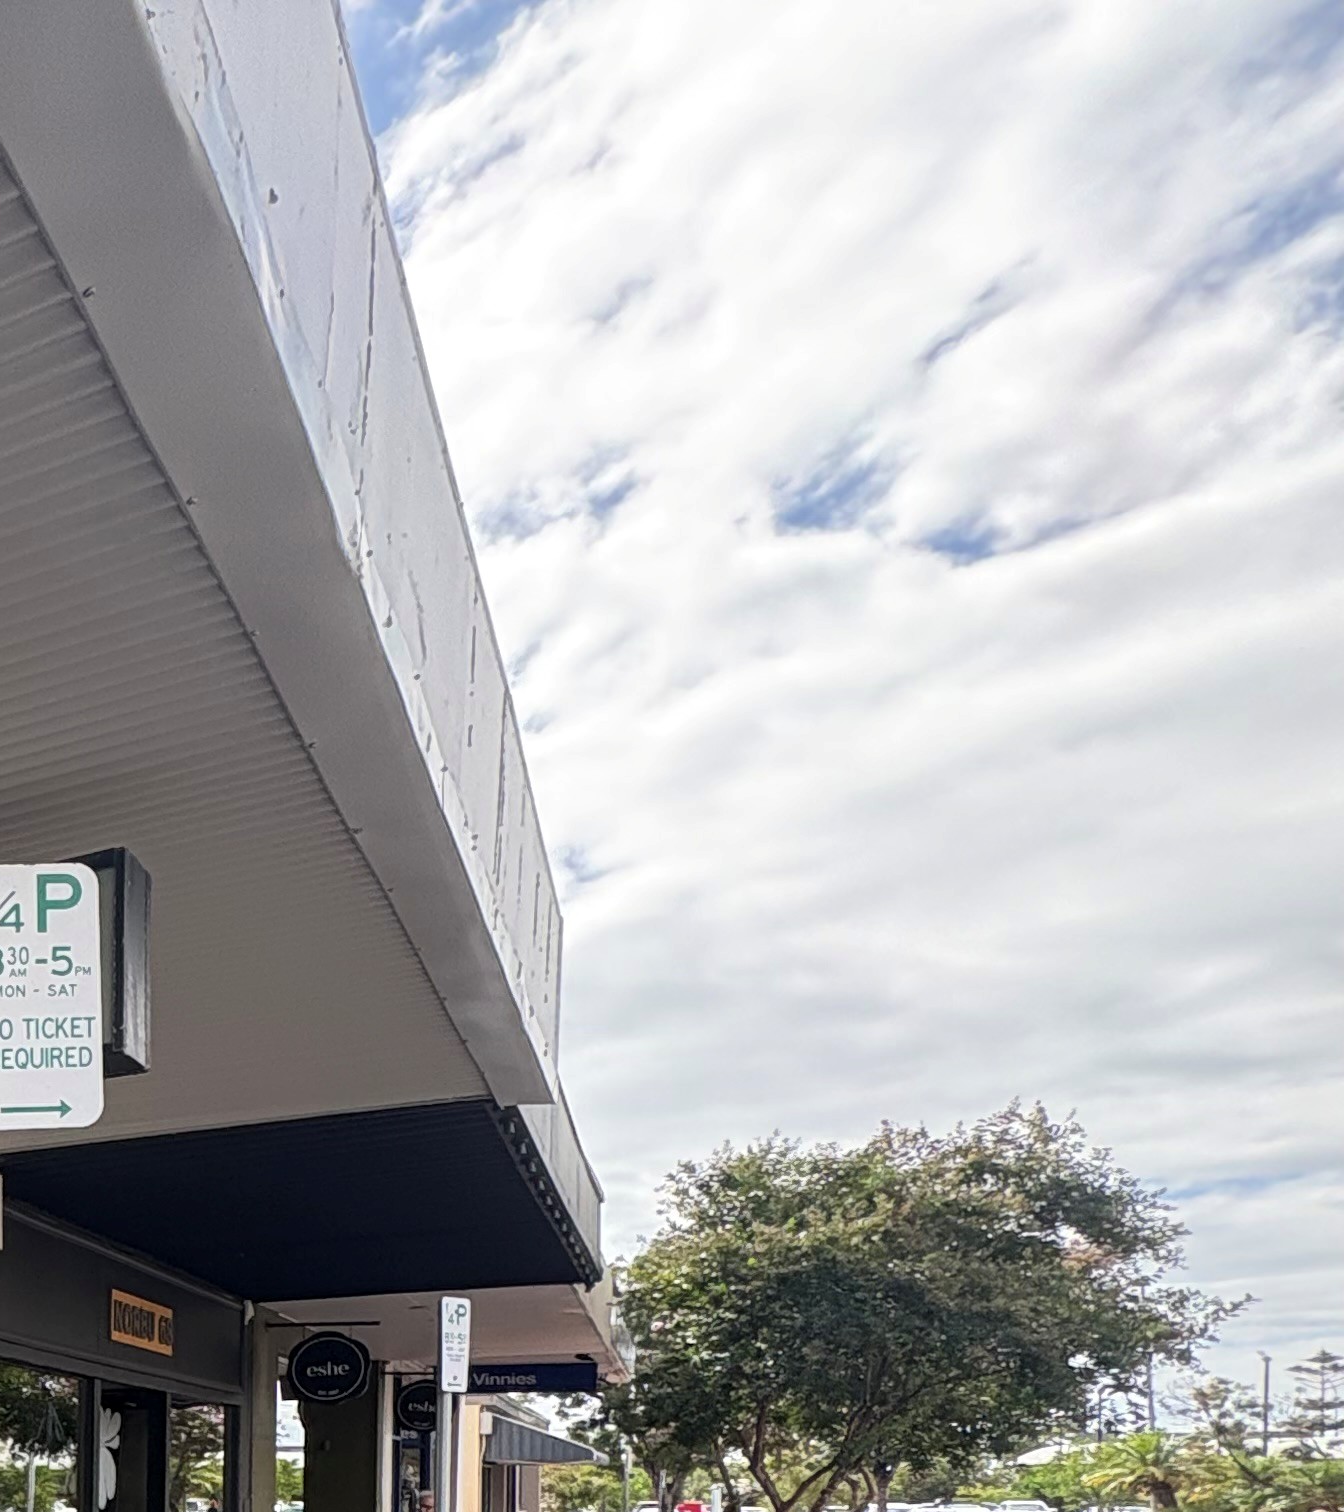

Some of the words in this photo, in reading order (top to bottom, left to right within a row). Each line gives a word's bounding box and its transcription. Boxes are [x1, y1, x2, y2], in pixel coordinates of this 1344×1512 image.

[8, 968, 28, 978] AM
[74, 965, 92, 976] PM
[47, 983, 78, 997] SAT
[22, 1015, 97, 1039] TICKET
[306, 1360, 351, 1378] eshe
[472, 1372, 537, 1387] Vinnies
